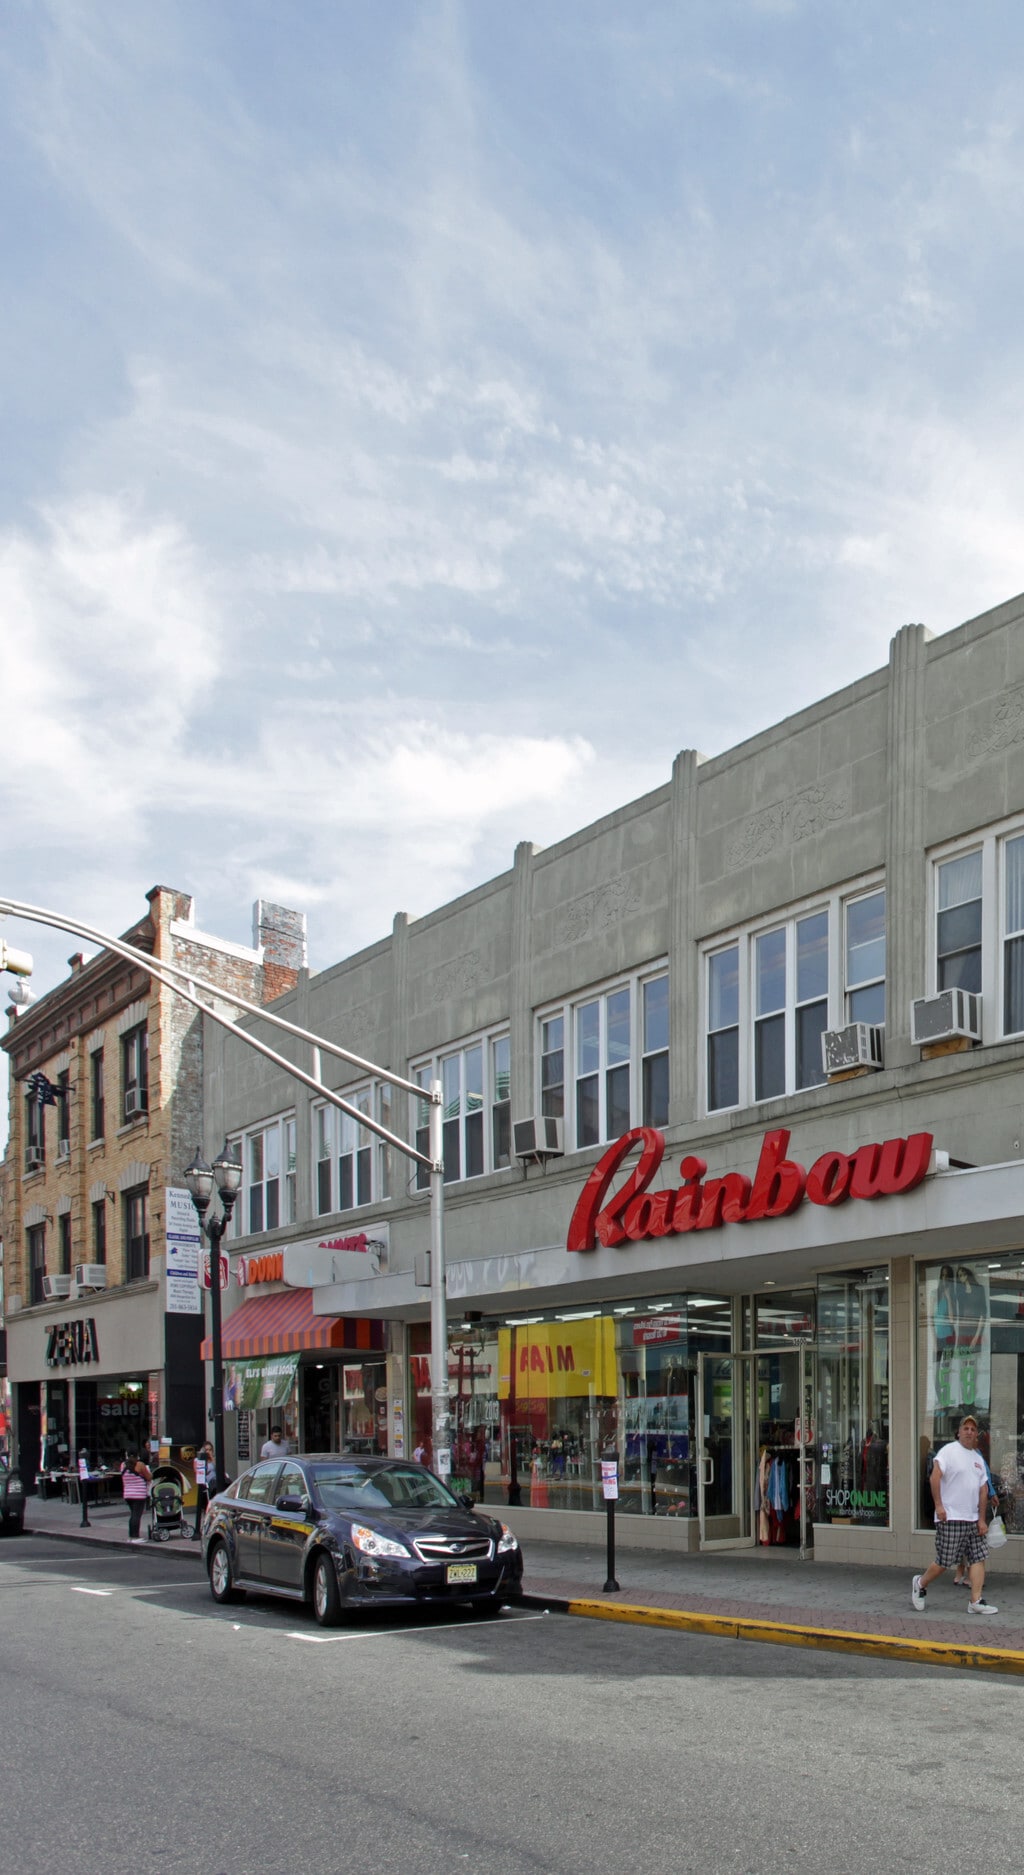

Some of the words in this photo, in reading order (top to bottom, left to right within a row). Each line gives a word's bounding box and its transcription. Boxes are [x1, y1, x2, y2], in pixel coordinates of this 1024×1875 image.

[567, 1126, 934, 1252] Rainbow
[825, 1488, 850, 1506] SHOP
[850, 1489, 887, 1508] ONLINE
